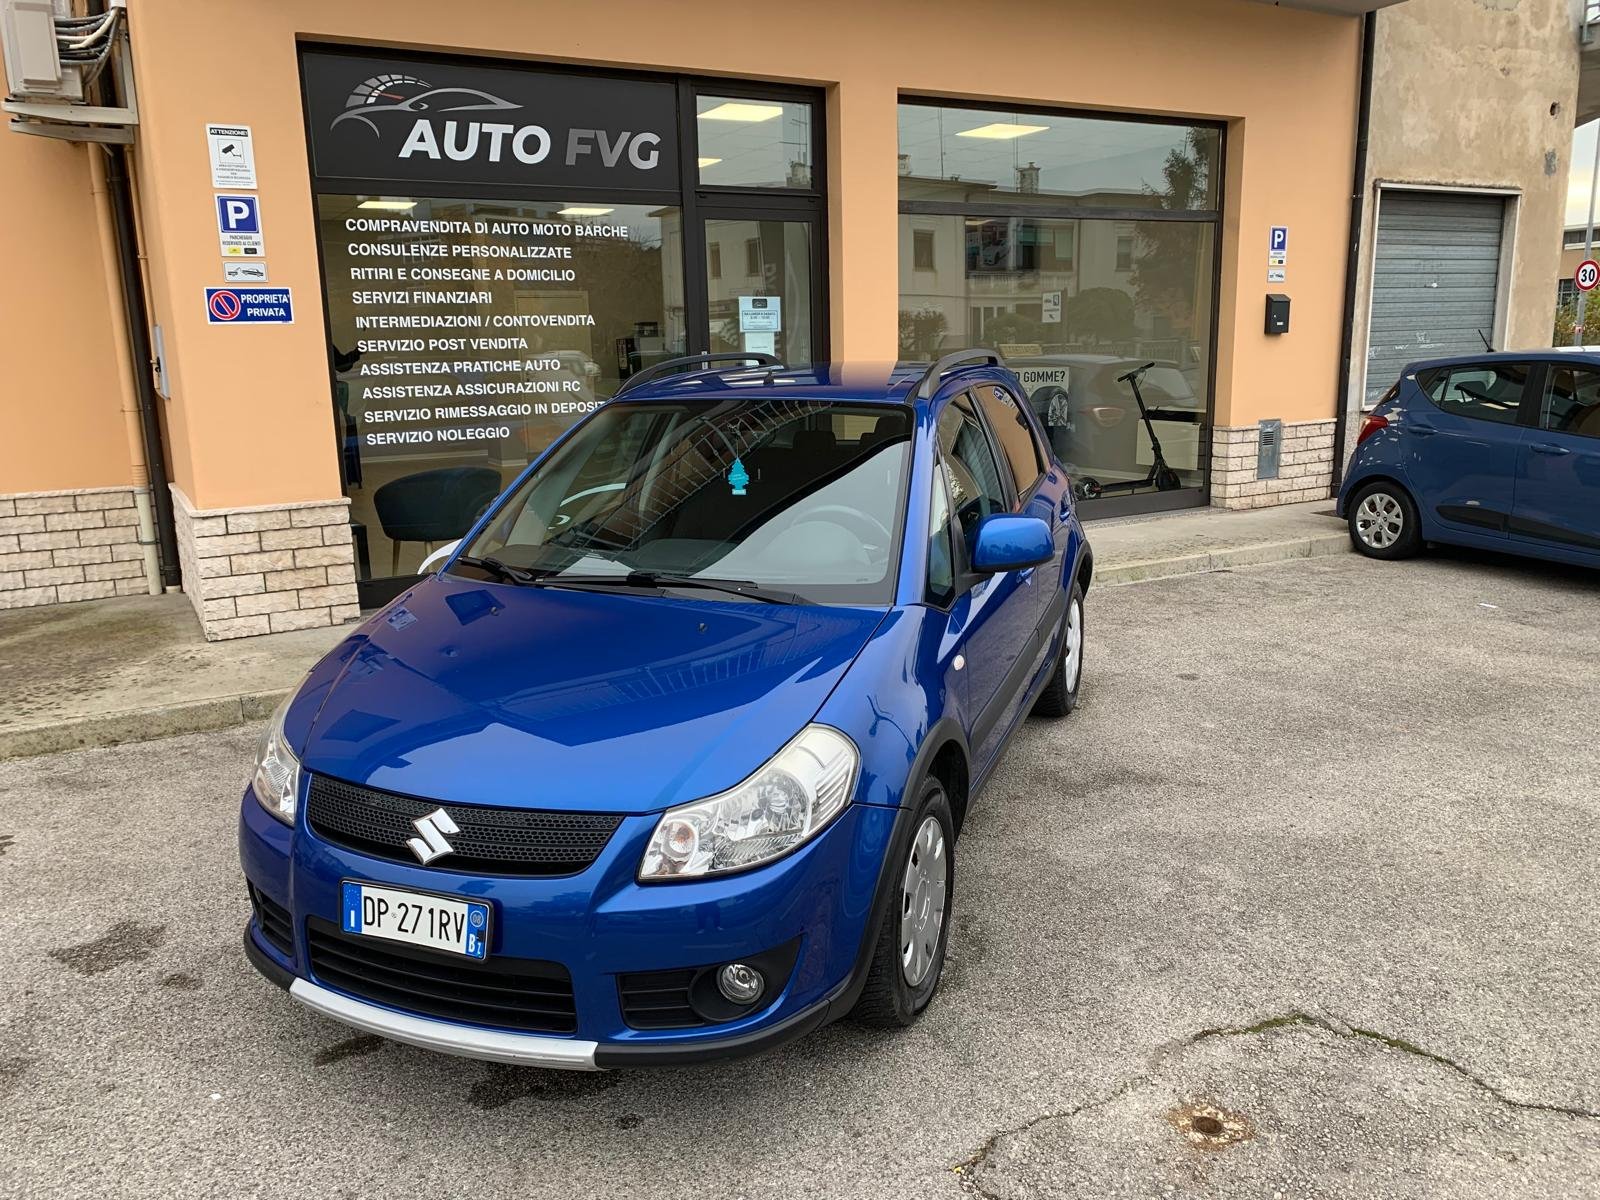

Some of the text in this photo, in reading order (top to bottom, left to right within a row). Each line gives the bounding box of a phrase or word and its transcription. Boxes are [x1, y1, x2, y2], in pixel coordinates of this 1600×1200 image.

[398, 119, 662, 170] AUTO FVG
[226, 200, 250, 229] P
[346, 219, 628, 237] COMPRAVENDITA DI AUTO MOTO BARCHE
[1274, 230, 1284, 248] P
[348, 244, 572, 258] CONSULENZE PERSONALIZZATE
[351, 268, 576, 281] RITIRI E CONSEGNE A DOMICILIO
[1580, 268, 1595, 282] 30
[352, 292, 492, 304] SERVIZI FINANZIARI
[246, 308, 286, 316] PRIVATA
[356, 314, 595, 328] INTERMEDIAZIONI / CONTOVENDITA
[357, 338, 528, 352] SERVIZIO POST VENDITA
[360, 359, 560, 375] ASSISTENZA PRATICHE AUTO
[1024, 370, 1066, 382] GOMME?
[363, 381, 580, 399] ASSISTENZA ASSICURAZIONI RC
[364, 409, 431, 423] SERVIZIO
[435, 404, 531, 420] RIMESSAGGIO
[535, 403, 548, 415] IN
[366, 427, 510, 445] SERVIZIO NOLEGGIO
[350, 910, 355, 928] I
[364, 896, 465, 943] DP 271RV
